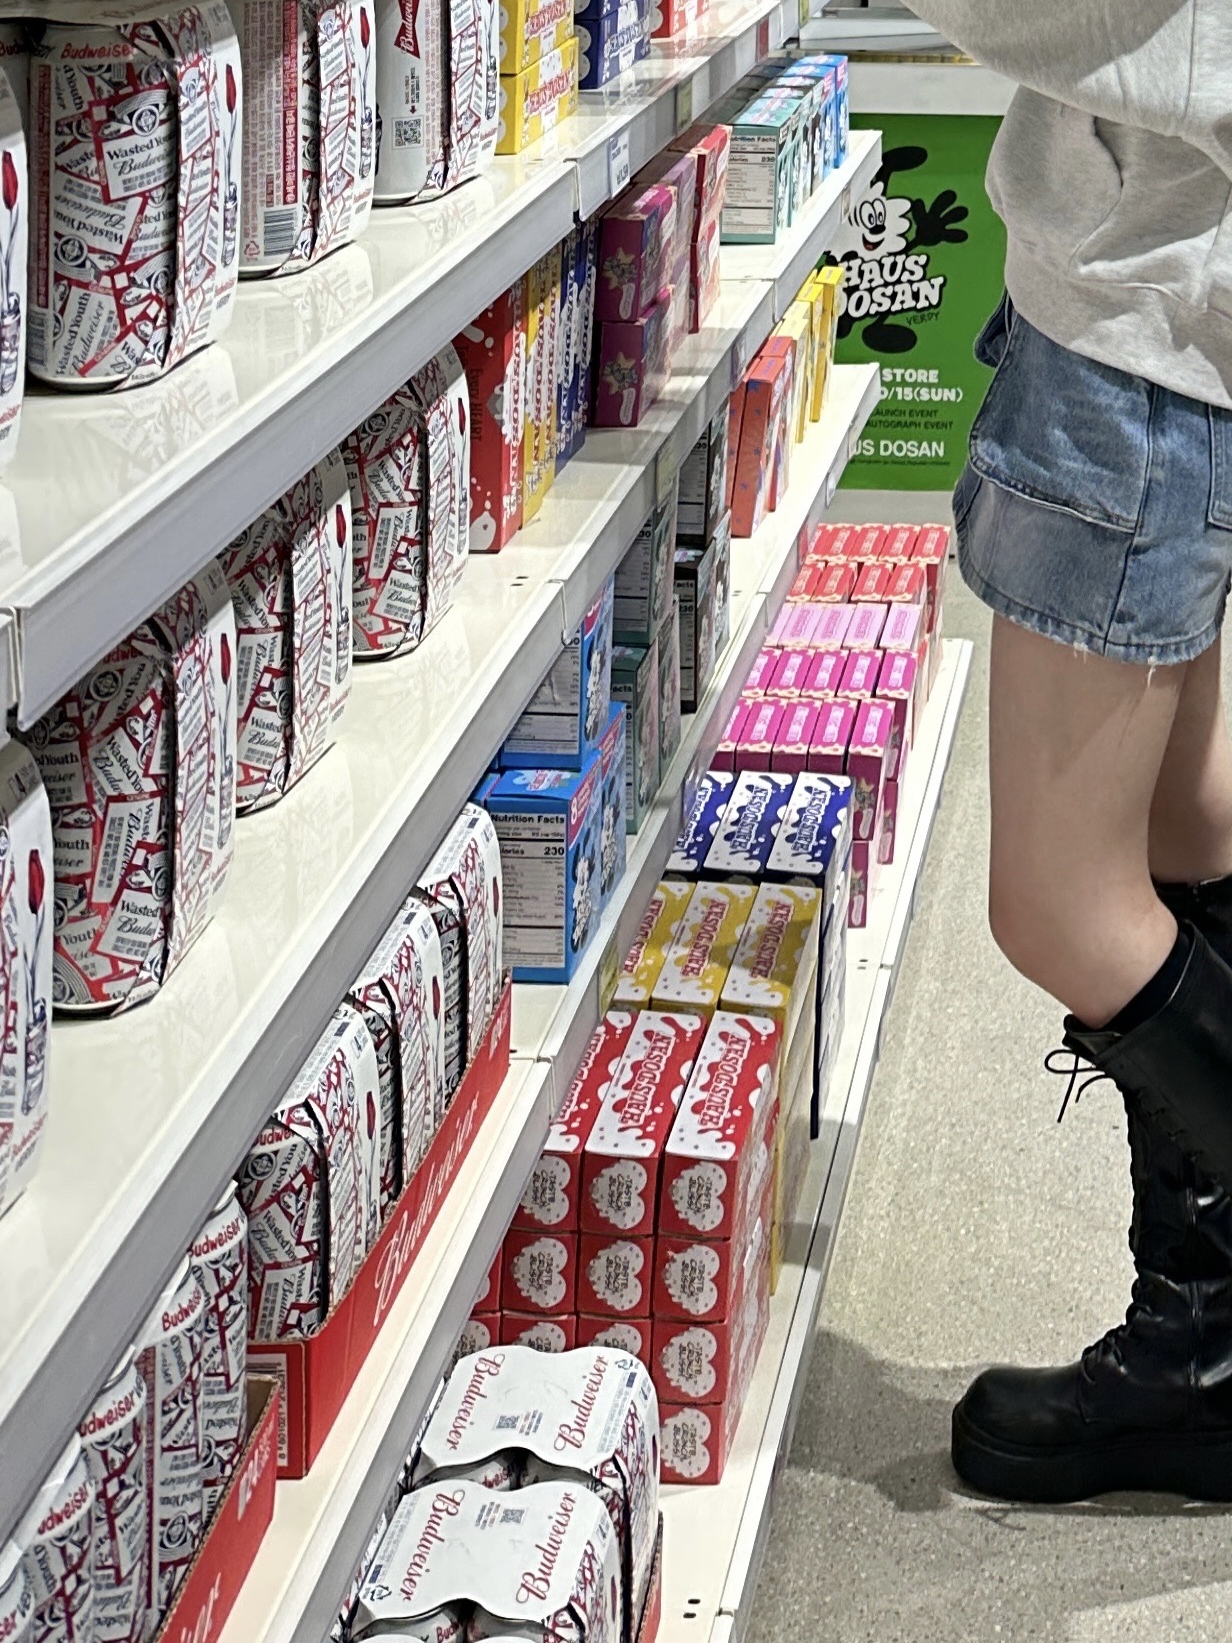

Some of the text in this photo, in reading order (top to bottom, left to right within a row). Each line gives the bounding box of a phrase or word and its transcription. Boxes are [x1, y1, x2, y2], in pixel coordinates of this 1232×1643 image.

[106, 140, 153, 161] Wasted
[56, 292, 91, 375] Wasted Youth
[905, 310, 940, 327] VERDY
[881, 368, 939, 384] STORE
[469, 368, 484, 443] Every HEART
[909, 409, 938, 419] EVENT
[924, 420, 954, 431] EVENT
[879, 440, 944, 458] DOSAN
[107, 734, 136, 779] Wasted
[491, 814, 565, 824] Nutrition Facts
[543, 846, 565, 856] 230
[681, 899, 729, 978] HAUS DOSAN
[750, 900, 795, 980] HAUS DOSAN
[620, 1031, 676, 1128] HAUS DOSAN
[699, 1033, 750, 1131] HAUS DOSAN
[78, 1389, 135, 1438] udweiser
[446, 1353, 506, 1451] Budweiser
[553, 1355, 610, 1452] Budweiser
[37, 1479, 89, 1536] udweiser
[399, 1488, 466, 1602] Budweiser
[515, 1490, 577, 1605] Budweiser
